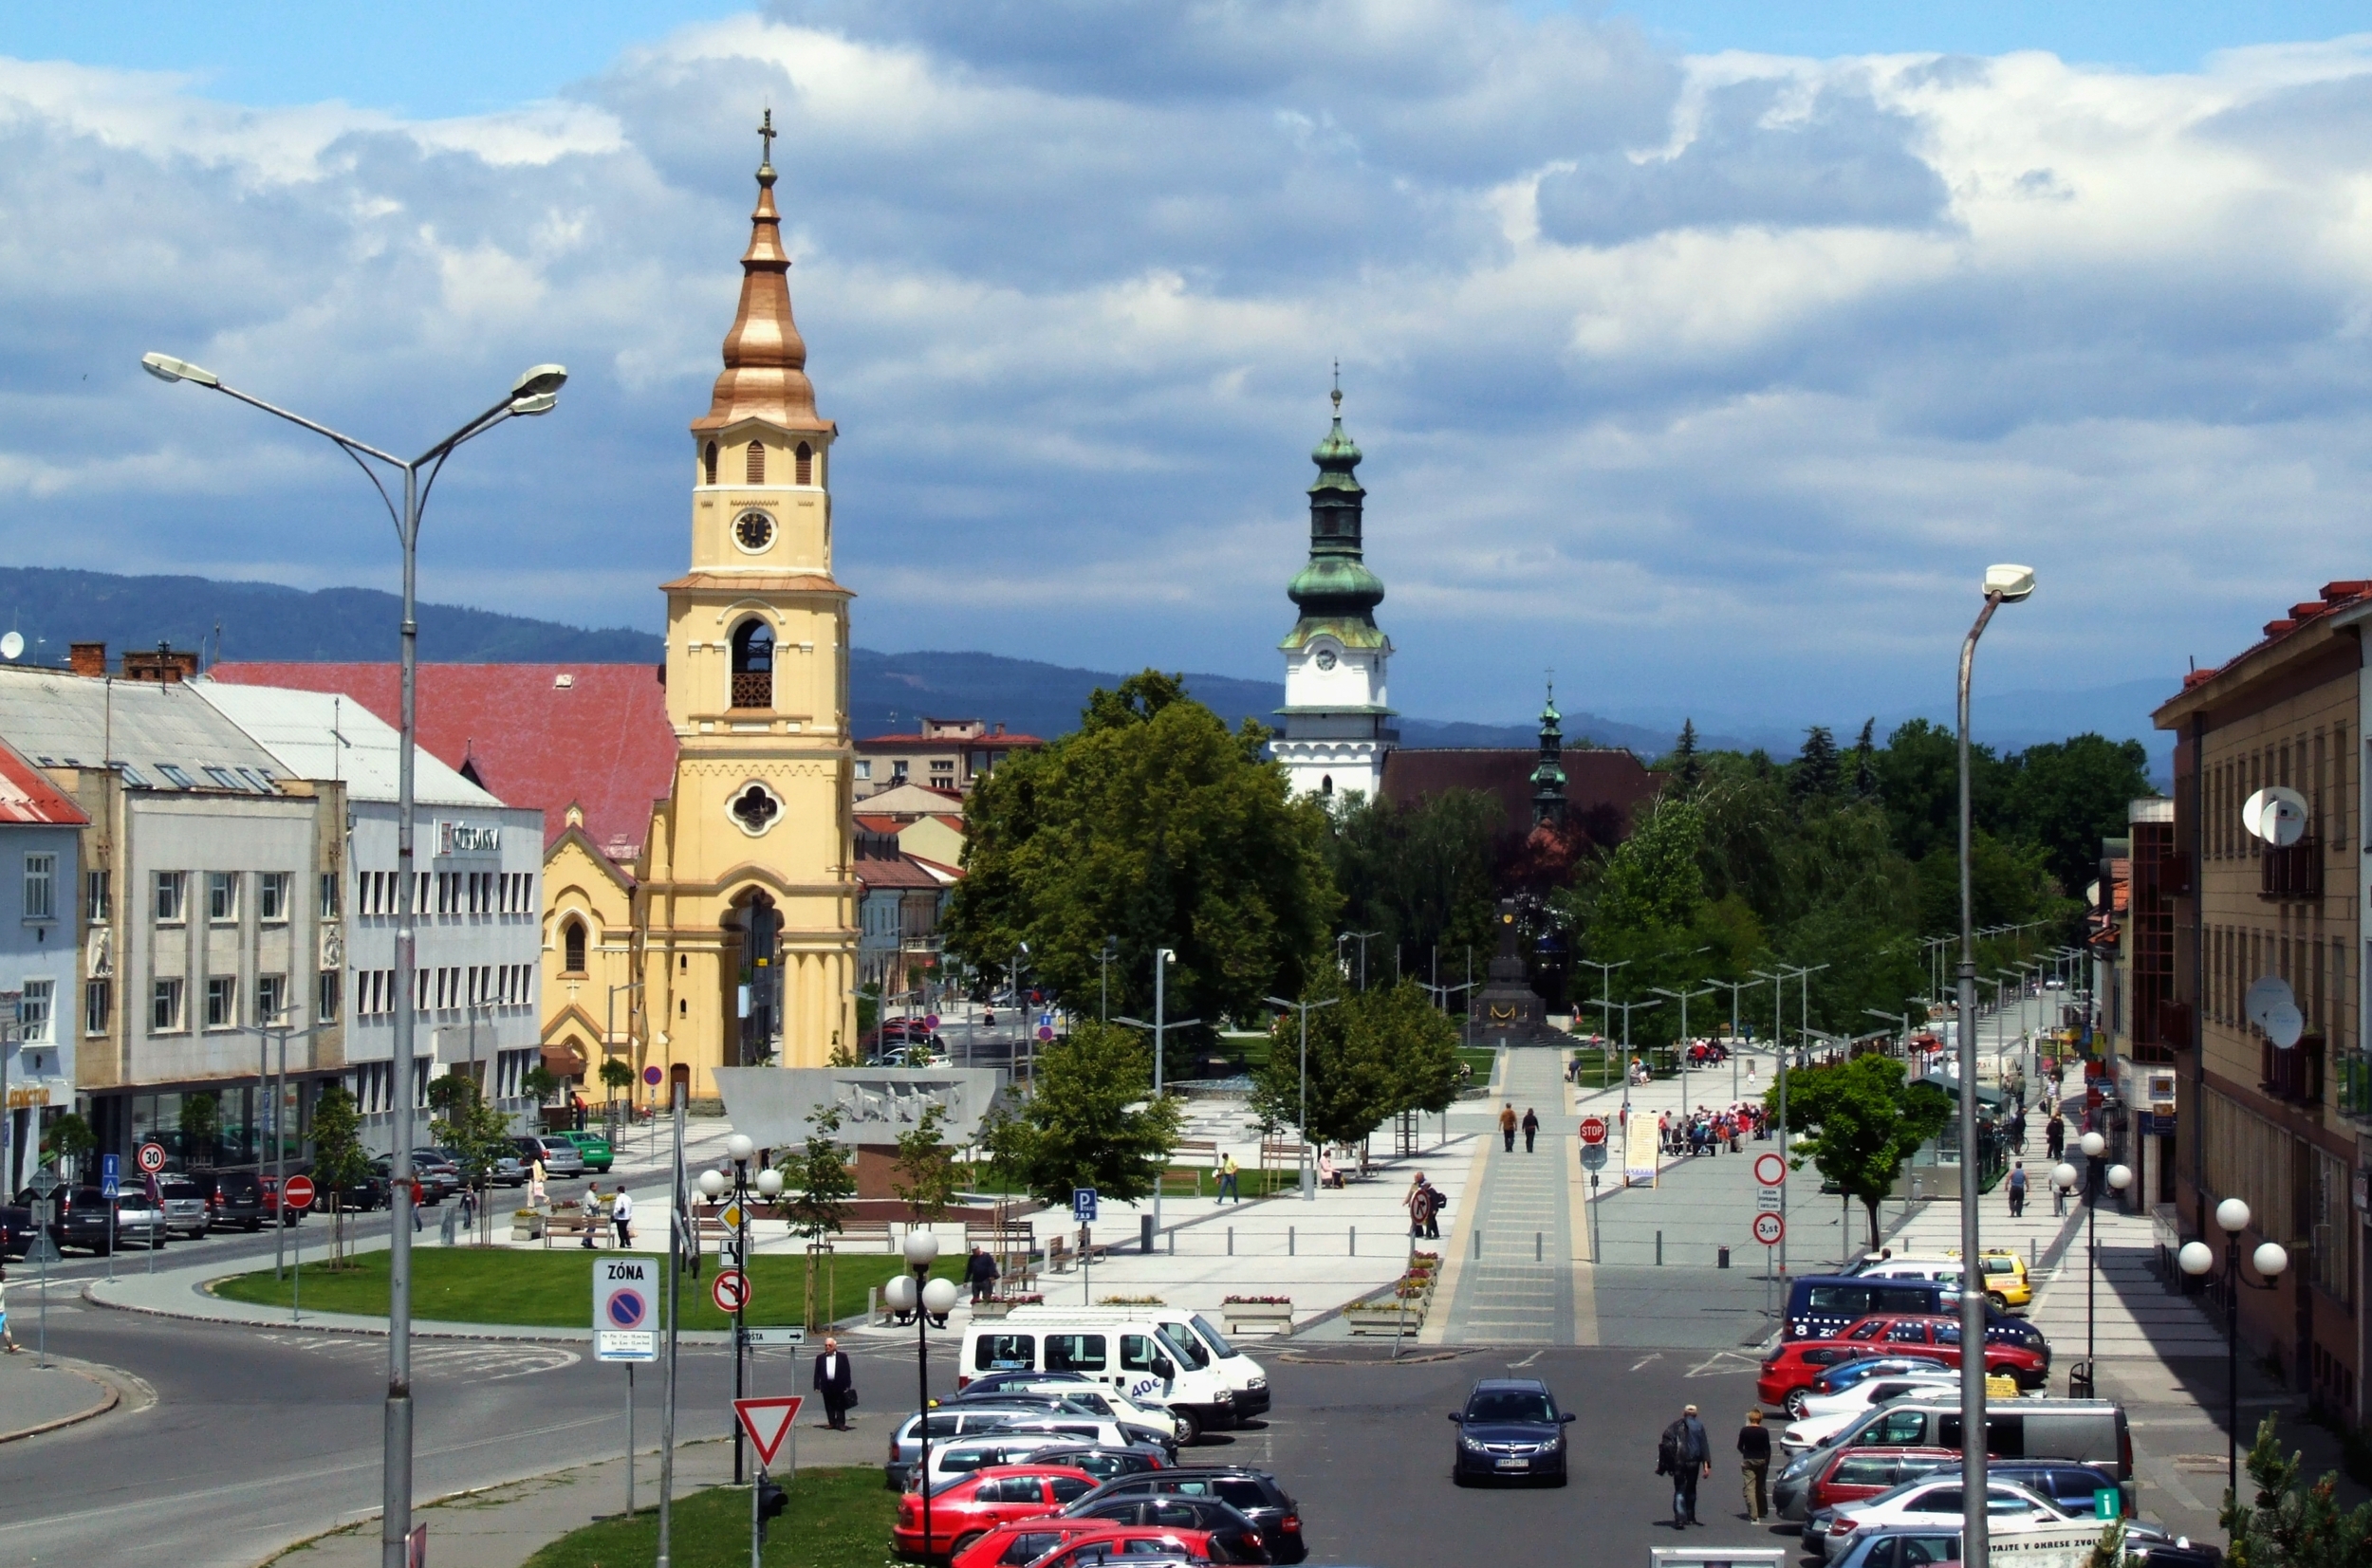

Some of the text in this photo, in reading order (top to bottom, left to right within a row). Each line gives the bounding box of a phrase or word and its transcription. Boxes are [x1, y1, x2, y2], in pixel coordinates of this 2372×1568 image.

[1582, 1126, 1603, 1136] STOP
[146, 1152, 159, 1164] 30
[1080, 1192, 1090, 1211] P
[608, 1262, 644, 1280] ZÓNA
[742, 1332, 763, 1340] POŠTA
[1132, 1378, 1161, 1397] 40€
[1988, 1543, 2019, 1553] ITAJTE
[2034, 1540, 2070, 1549] OKRESE
